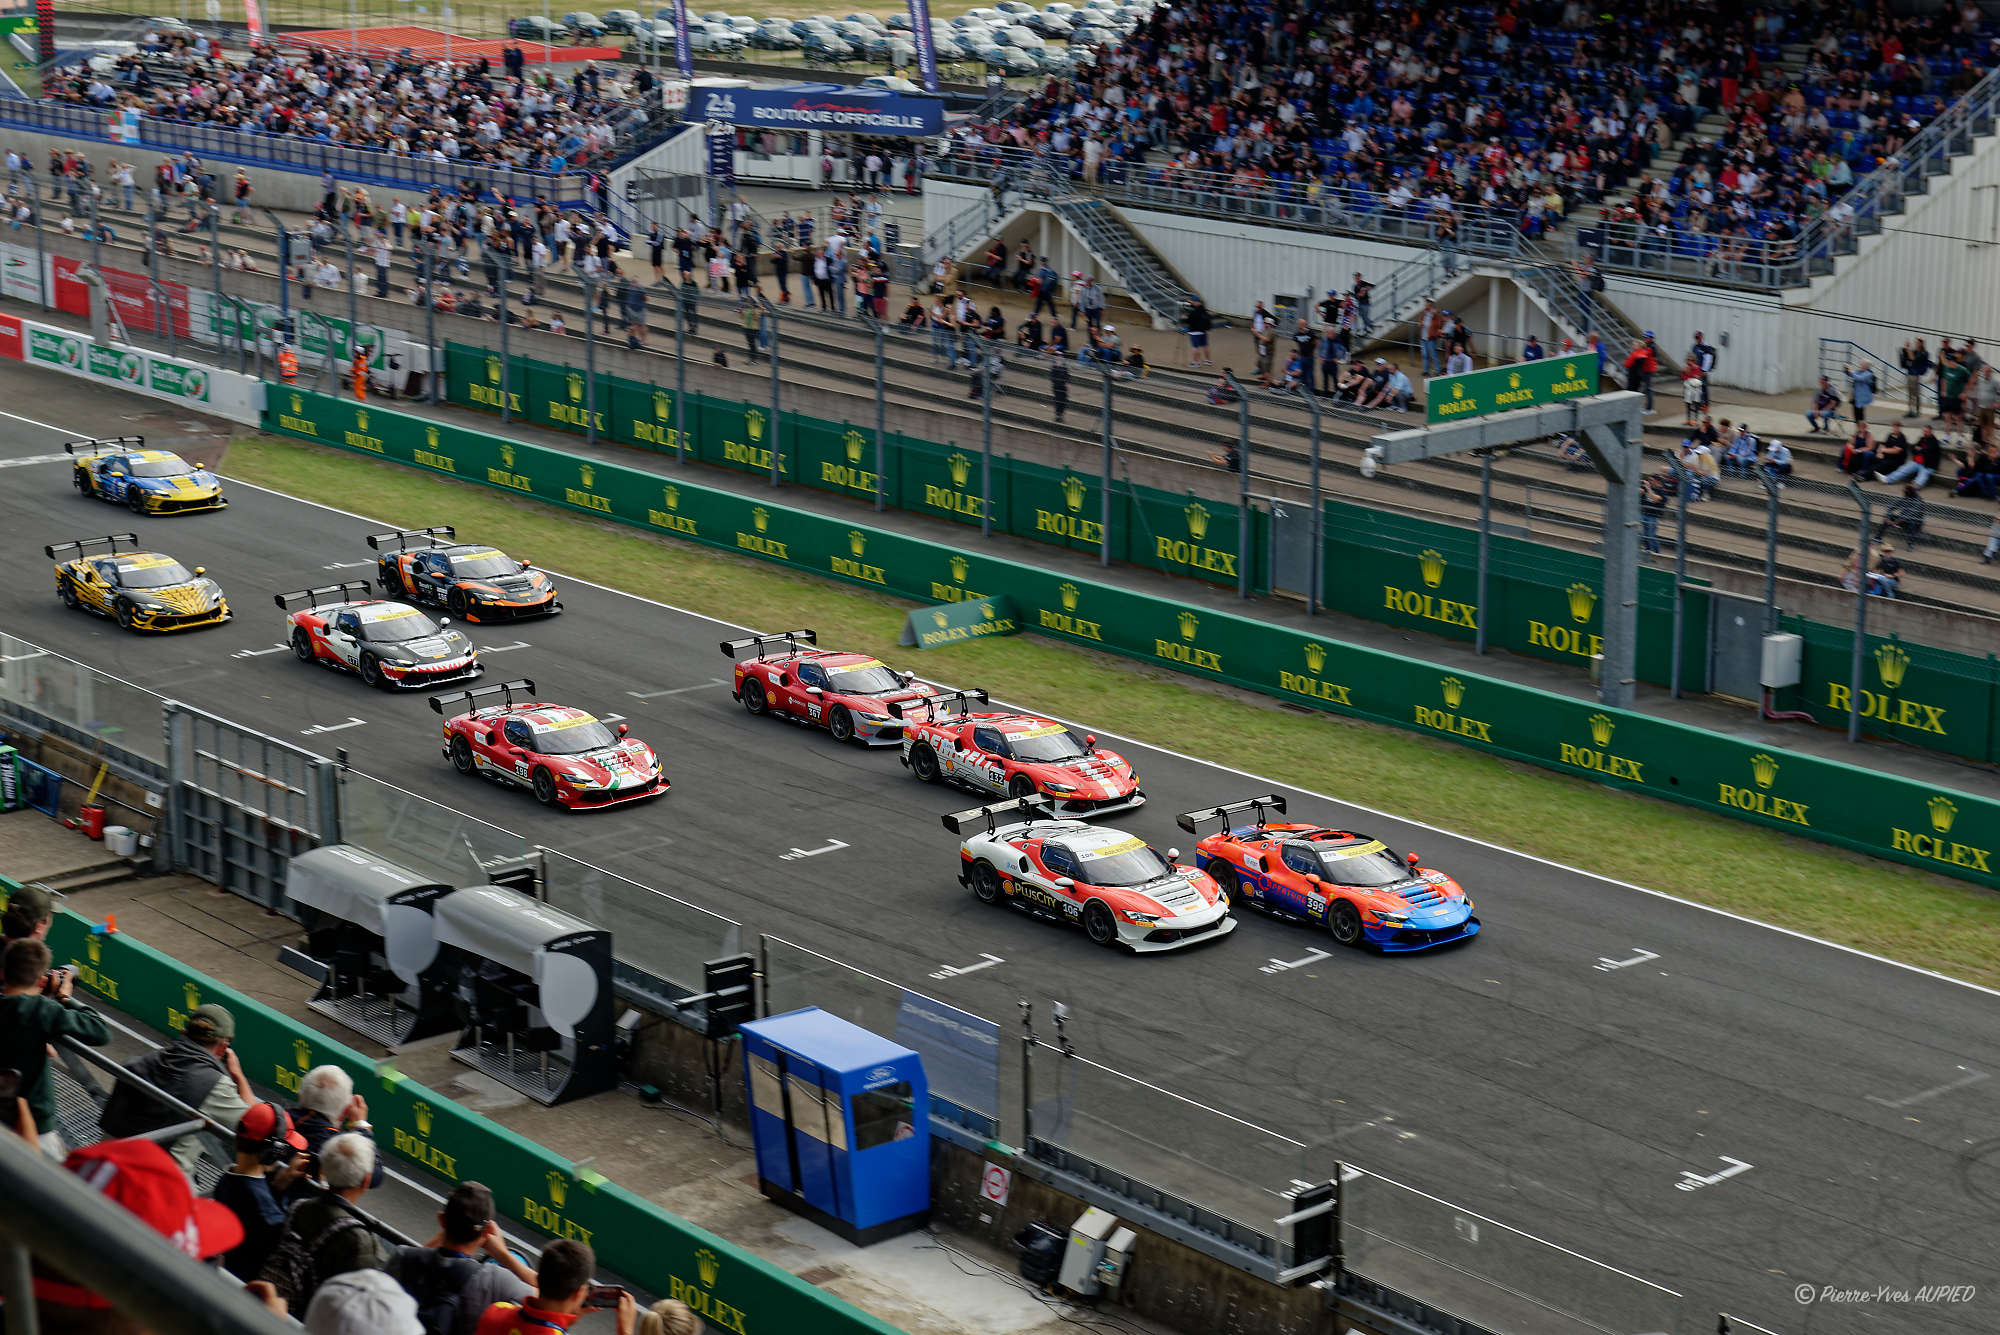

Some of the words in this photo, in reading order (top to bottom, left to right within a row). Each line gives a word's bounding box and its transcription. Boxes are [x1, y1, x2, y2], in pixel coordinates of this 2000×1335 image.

[753, 106, 834, 124] BOUTIQUE
[834, 110, 924, 129] OFFICIELLE
[1495, 388, 1534, 405] ROLEX
[1552, 378, 1590, 395] ROLEX
[1438, 399, 1477, 416] ROLEX
[279, 414, 317, 436] ROLEX
[345, 430, 385, 454] ROLEX
[413, 449, 456, 473] ROLEX
[487, 467, 532, 492] ROLEX
[565, 488, 612, 513] ROLEX
[648, 509, 698, 536] ROLEX
[736, 531, 789, 560] ROLEX
[1156, 535, 1238, 577] ROLEX
[830, 556, 886, 585] ROLEX
[1383, 585, 1479, 630] ROLEX
[922, 627, 969, 646] ROLEX
[969, 619, 1016, 637] ROLEX
[1040, 609, 1103, 642] ROLEX
[1155, 639, 1223, 673] ROLEX
[1279, 671, 1353, 706] ROLEX
[1826, 681, 1948, 736] ROLEX
[1414, 704, 1493, 743] ROLEX
[1559, 742, 1644, 783] ROLEX
[989, 771, 1005, 786] 132
[1718, 783, 1811, 827] ROLEX
[1062, 903, 1079, 917] 106
[1306, 897, 1324, 913] 399
[393, 1126, 458, 1181] ROLEX
[668, 1273, 748, 1335] ROLEX
